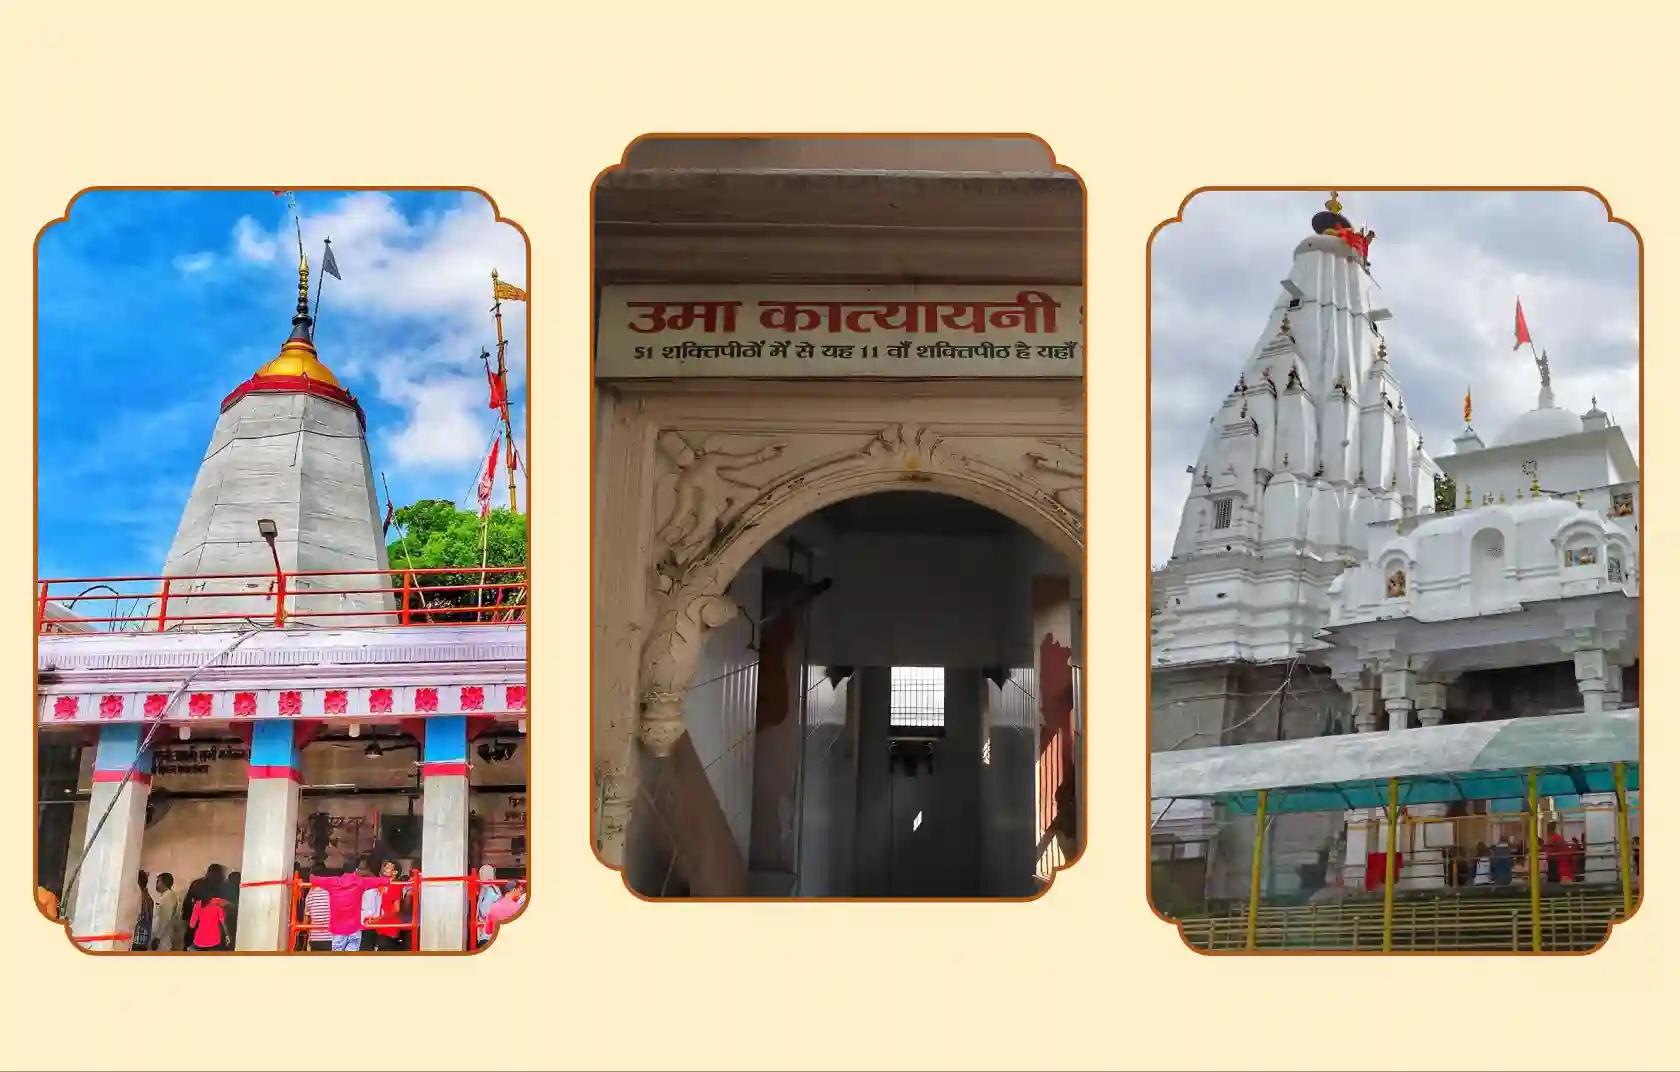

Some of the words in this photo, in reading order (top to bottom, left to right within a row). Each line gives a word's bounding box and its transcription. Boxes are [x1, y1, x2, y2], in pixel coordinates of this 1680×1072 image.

[627, 301, 742, 334] उमा
[757, 291, 1061, 334] कात्यायनी
[633, 345, 654, 359] 51
[768, 340, 791, 359] में
[795, 341, 816, 358] से
[821, 345, 856, 358] यह
[861, 345, 878, 358] 11
[1014, 341, 1032, 359] है
